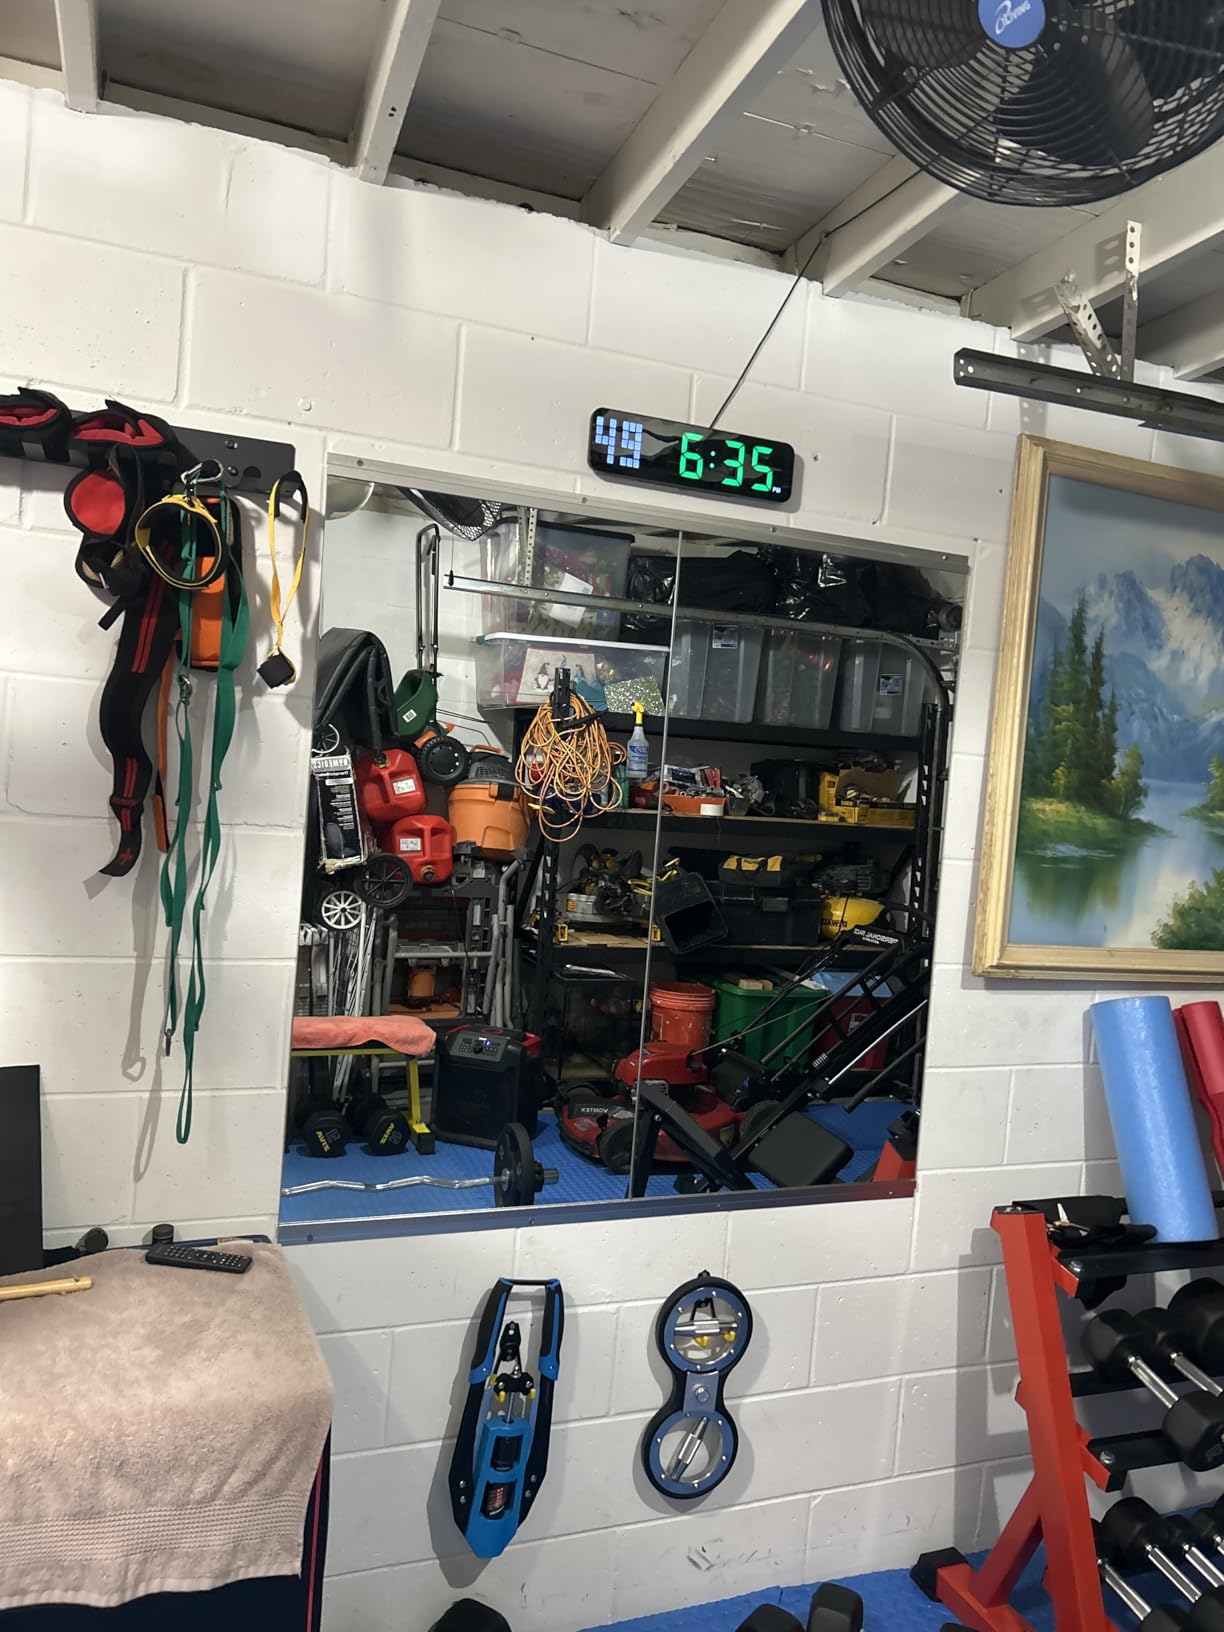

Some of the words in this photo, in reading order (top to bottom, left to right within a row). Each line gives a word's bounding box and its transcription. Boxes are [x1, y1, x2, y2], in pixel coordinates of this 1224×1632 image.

[595, 415, 643, 469] 49
[678, 431, 775, 492] 6:35
[772, 486, 782, 494] PM
